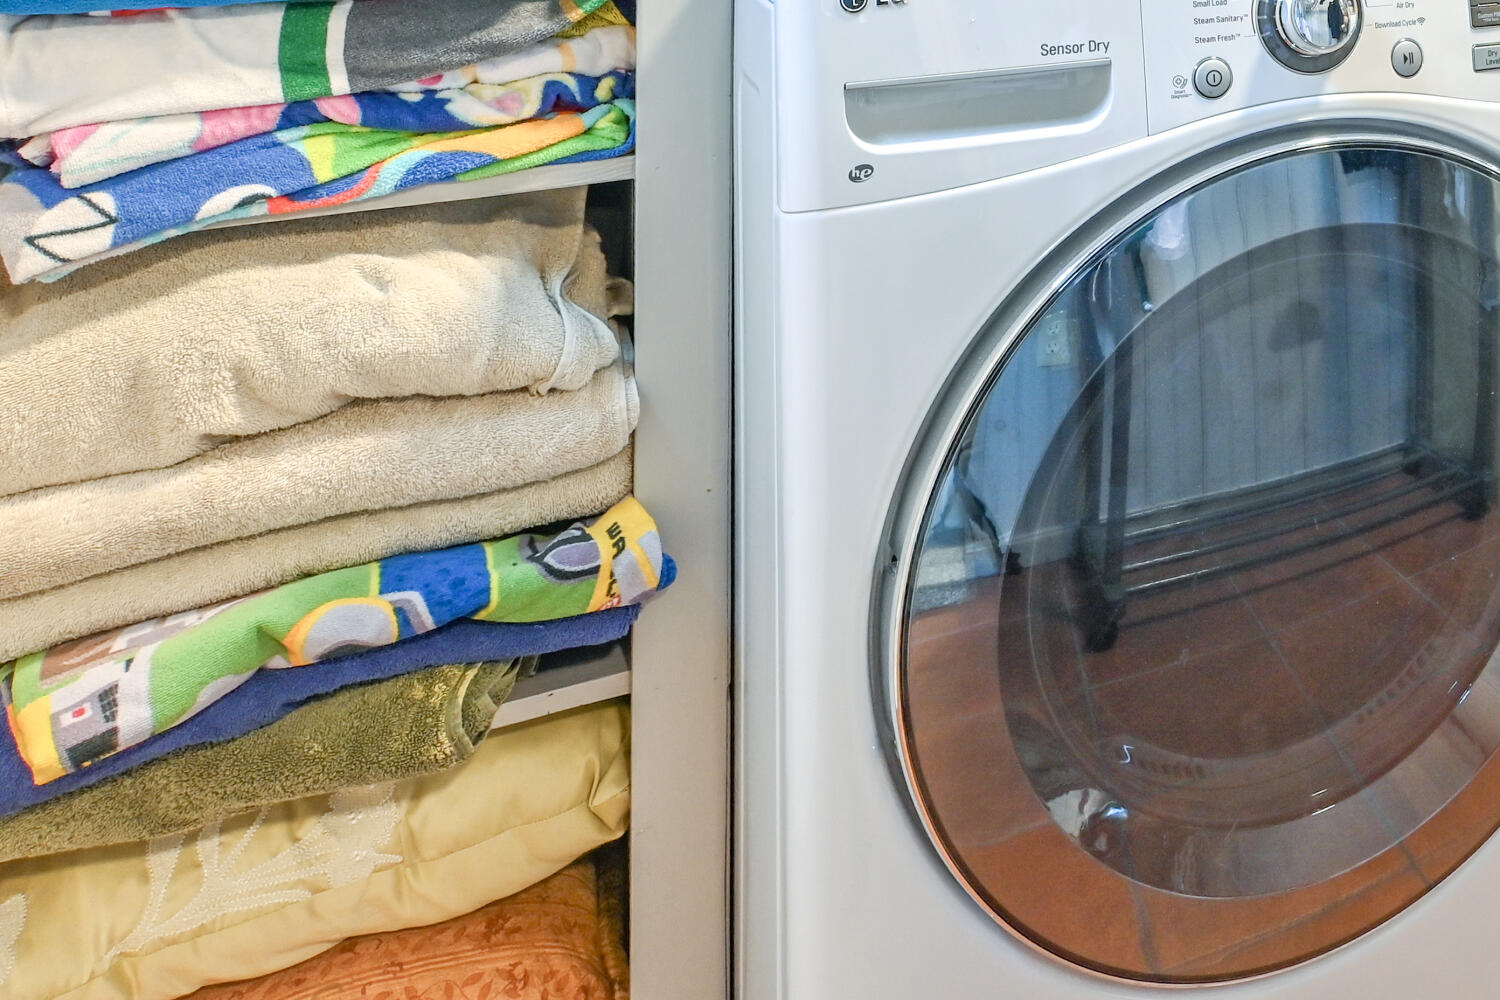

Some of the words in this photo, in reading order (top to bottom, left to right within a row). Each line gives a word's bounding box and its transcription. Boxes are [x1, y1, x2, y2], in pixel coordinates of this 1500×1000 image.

[1192, 0, 1211, 9] Small
[1211, 0, 1228, 7] Load
[1193, 17, 1215, 25] Steam
[1374, 20, 1402, 29] Download
[1402, 18, 1416, 27] Cycle
[1194, 36, 1216, 44] Steam
[1040, 42, 1085, 57] Sensor
[1088, 39, 1111, 54] Dry
[1487, 50, 1498, 59] Dry
[1485, 57, 1500, 66] Level
[849, 165, 874, 182] he
